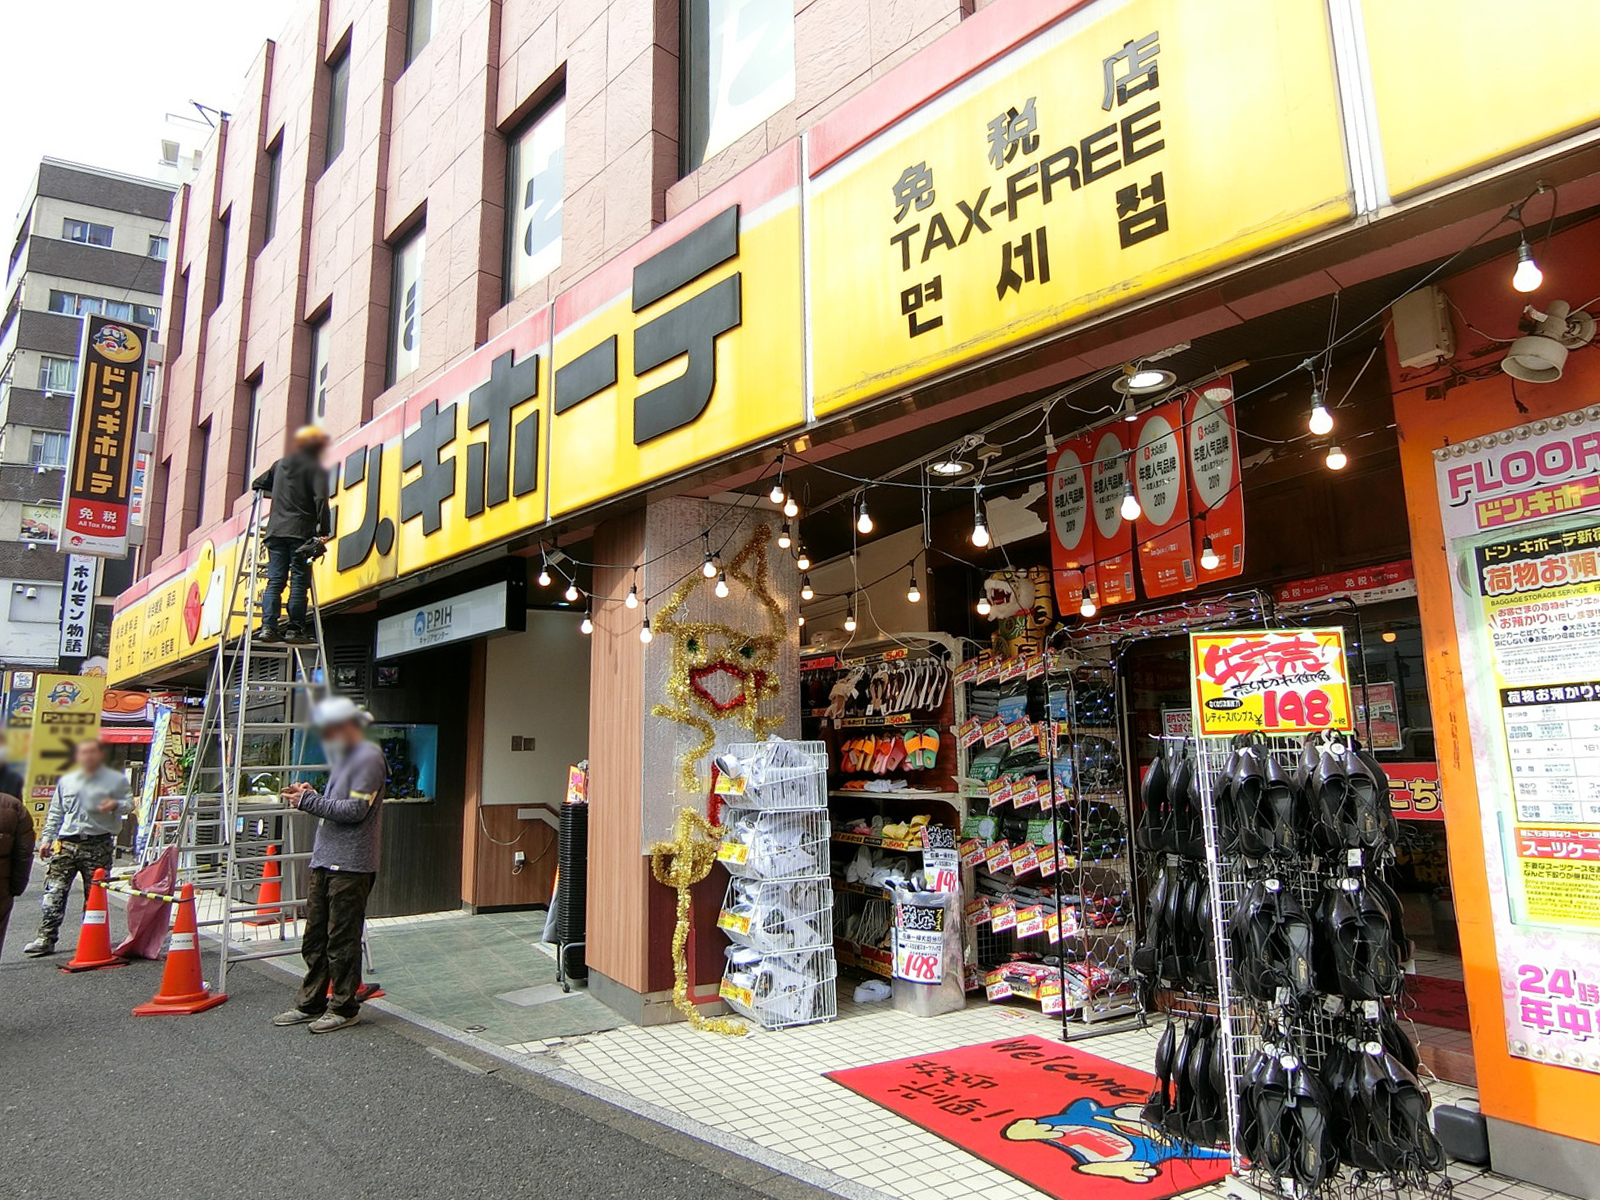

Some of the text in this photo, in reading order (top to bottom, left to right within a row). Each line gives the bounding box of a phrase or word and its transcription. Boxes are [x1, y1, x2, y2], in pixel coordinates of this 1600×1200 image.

[891, 30, 1160, 224] 免税店
[890, 101, 1166, 272] TAX-FREE
[901, 171, 1169, 338] 면세점
[1486, 550, 1600, 592] 荷物お預
[65, 565, 90, 653] ホルモン物語
[1491, 597, 1523, 606] BAGGAGE
[1524, 591, 1556, 601] STORAGE
[1558, 586, 1588, 597] SERVICE
[427, 605, 452, 630] PPIH
[1521, 840, 1600, 858] スーツケー
[904, 953, 939, 979] 198
[1521, 996, 1600, 1036] 年中
[990, 1038, 1147, 1099] Welcome
